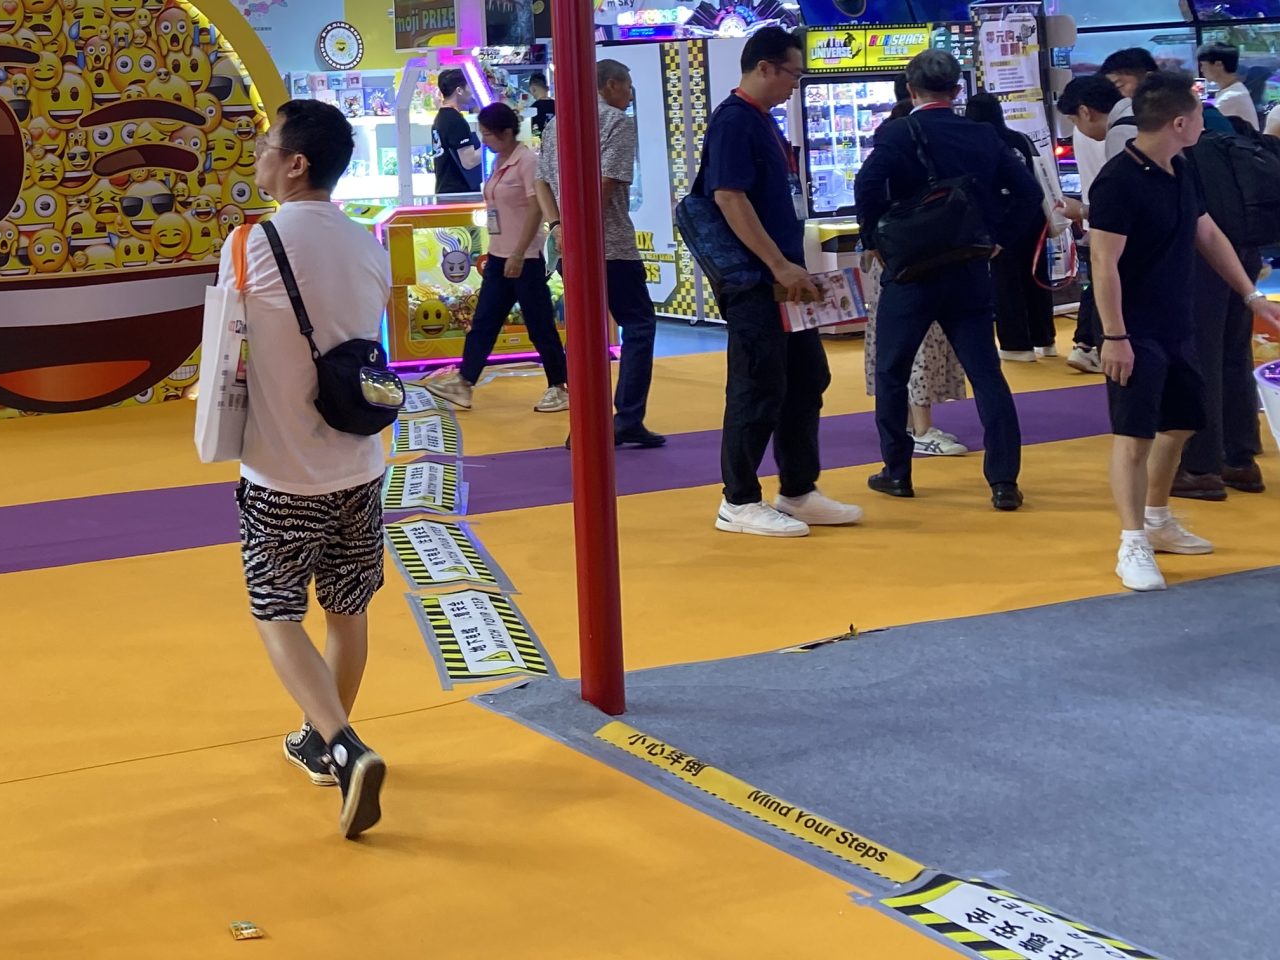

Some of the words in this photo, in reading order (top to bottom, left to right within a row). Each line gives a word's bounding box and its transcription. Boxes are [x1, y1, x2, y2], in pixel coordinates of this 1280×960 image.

[422, 6, 455, 30] PRIZE
[811, 47, 852, 59] UNIVERSE
[448, 601, 472, 620] 意安全
[471, 597, 488, 610] STEP
[488, 628, 509, 649] WATCH
[748, 790, 795, 818] Mind
[795, 809, 835, 837] Your
[836, 831, 889, 863] Steps
[987, 895, 1055, 925] STEP
